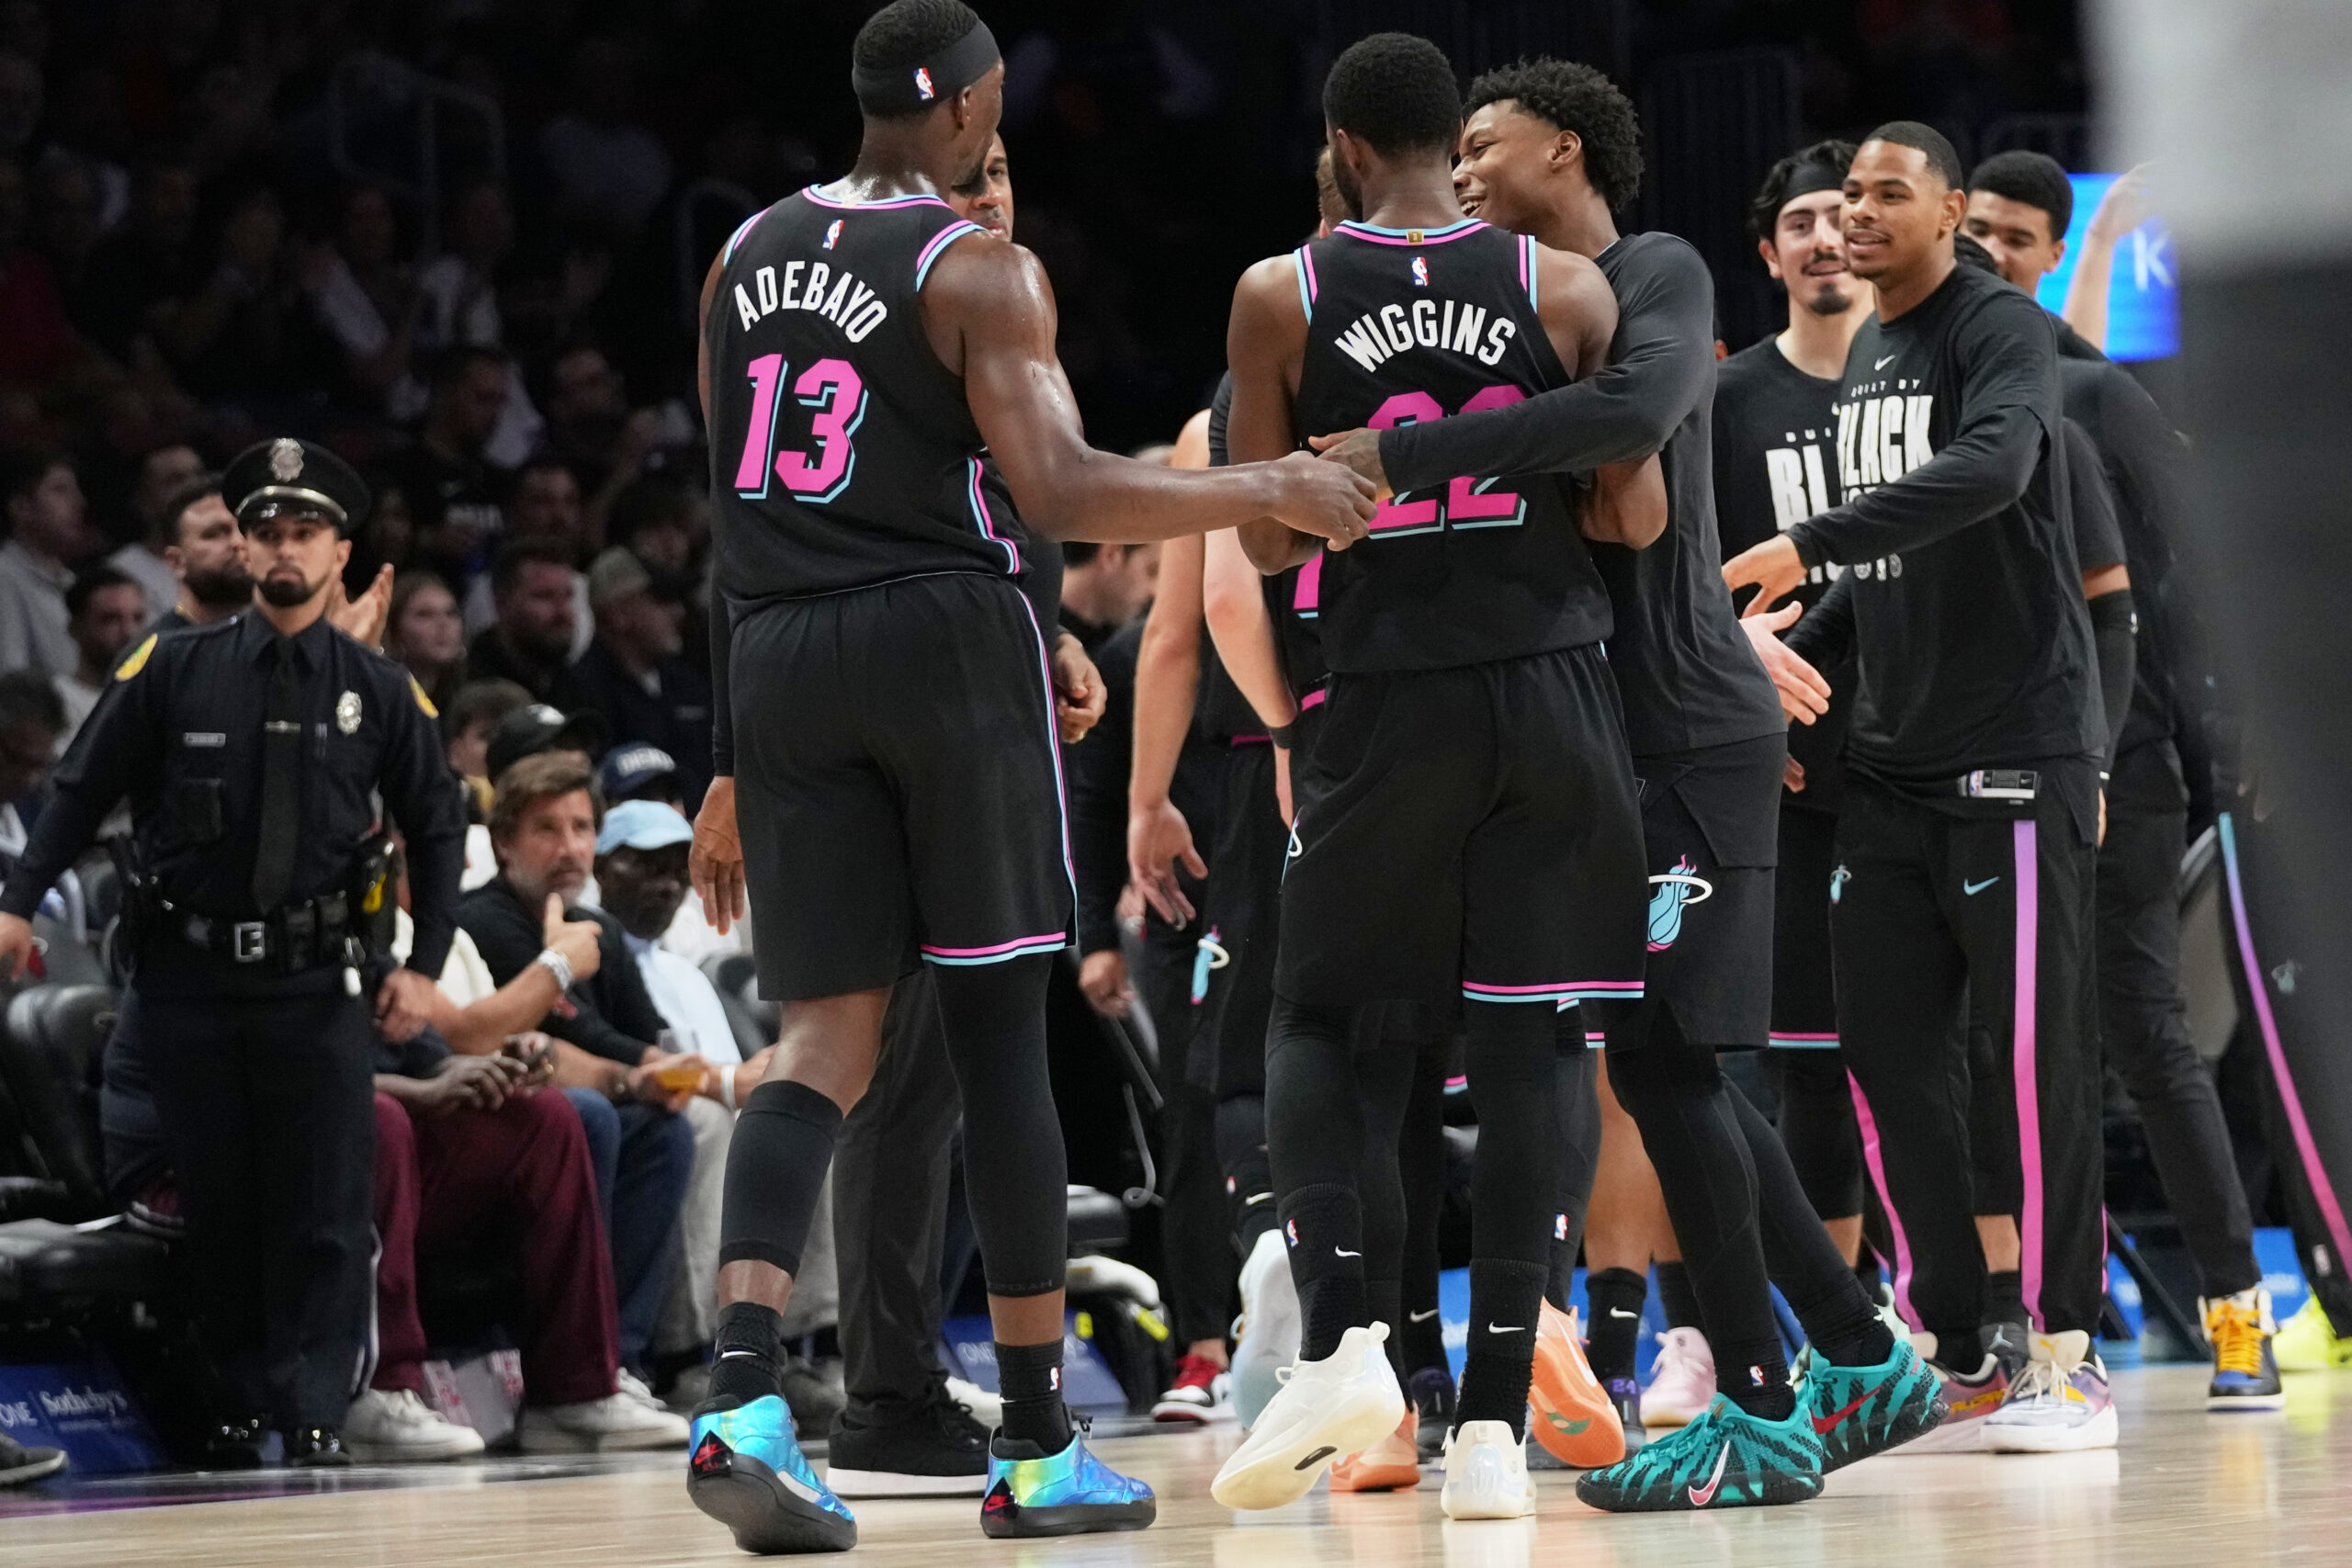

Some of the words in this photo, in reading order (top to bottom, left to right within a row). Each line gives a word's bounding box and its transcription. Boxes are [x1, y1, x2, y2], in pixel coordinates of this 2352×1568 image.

[734, 260, 888, 344] ADEBAYO
[1334, 299, 1516, 373] WIGGINS
[1898, 378, 1920, 389] BY
[735, 353, 869, 503] 13
[1366, 385, 1528, 539] 22
[1836, 395, 1935, 487] BLACK
[1611, 1379, 1635, 1394] 24
